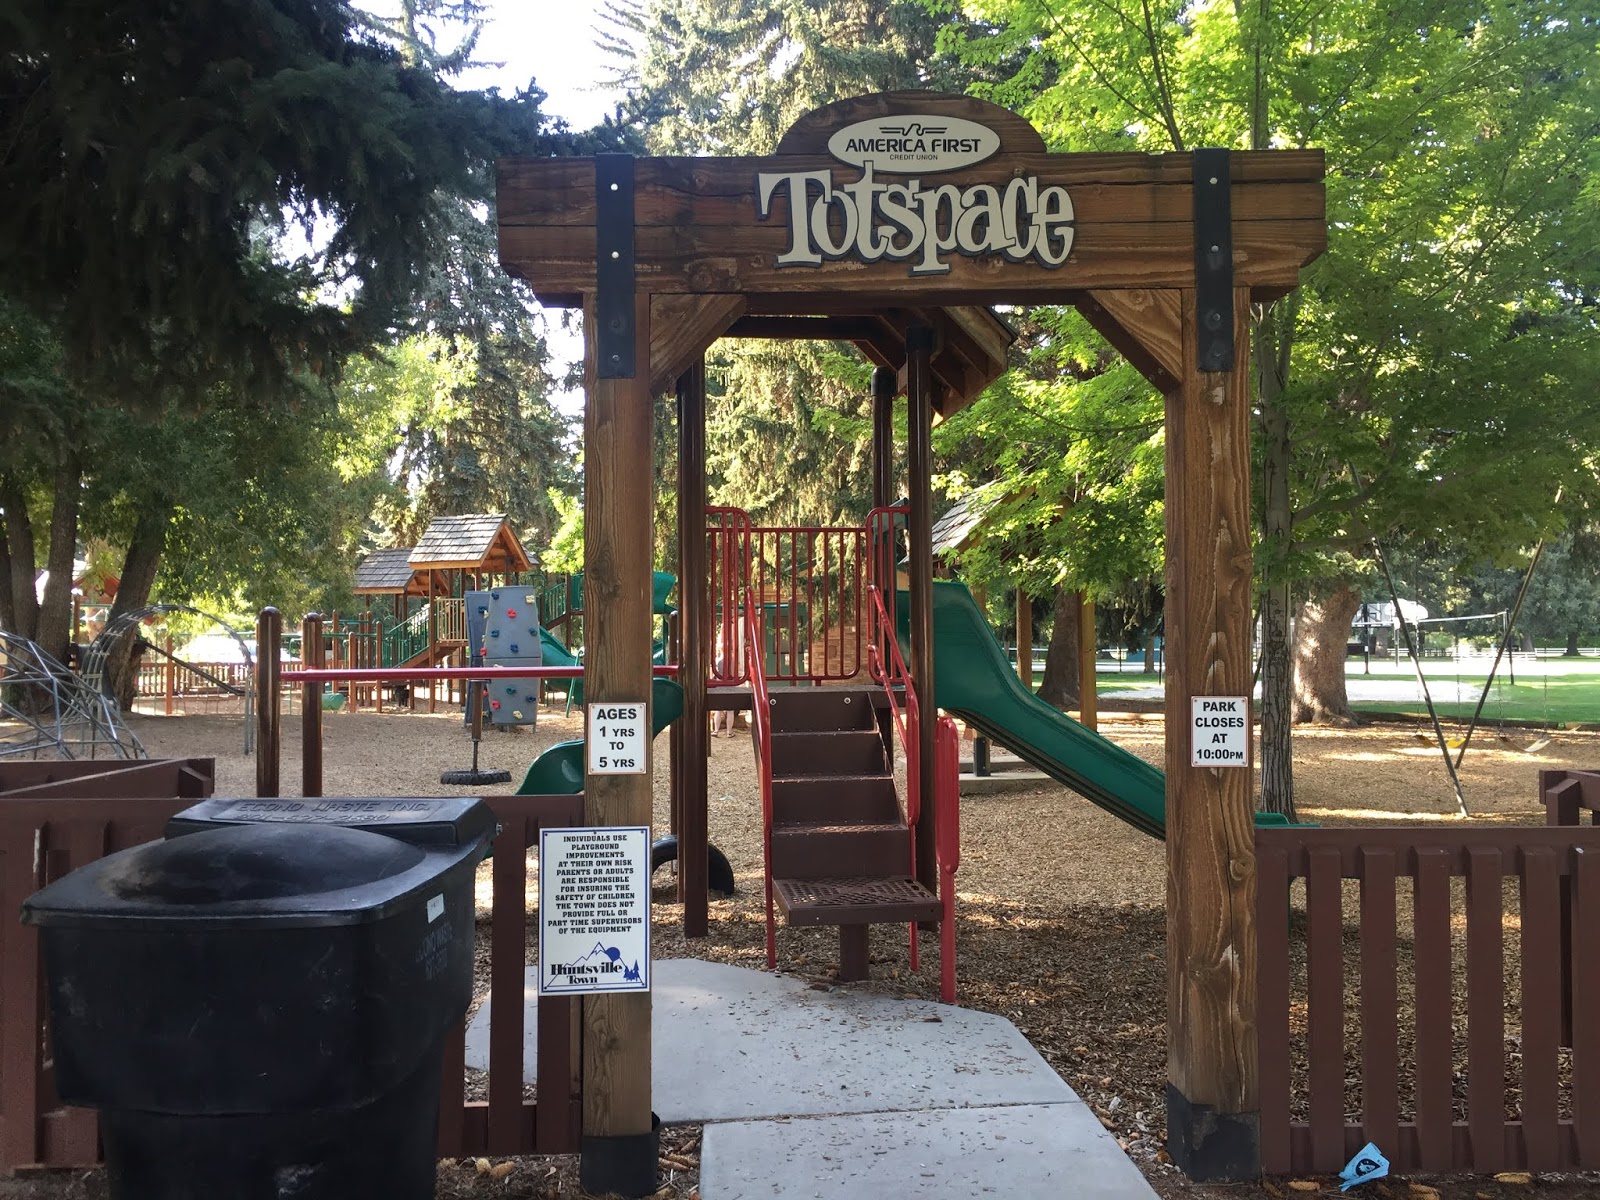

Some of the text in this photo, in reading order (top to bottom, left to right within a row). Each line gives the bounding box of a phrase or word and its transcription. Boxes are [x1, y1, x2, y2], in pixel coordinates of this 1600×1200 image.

[845, 139, 981, 152] AMERICA FIRST
[758, 160, 1075, 274] Totspace
[1203, 702, 1236, 712] PARK
[596, 708, 637, 720] AGES
[1195, 718, 1244, 728] CLOSES
[600, 726, 635, 737] 1 YRS
[1212, 734, 1228, 743] AT
[609, 742, 624, 750] TO
[1196, 749, 1243, 759] 10:00PM
[599, 757, 635, 768] 5 YRS
[236, 802, 431, 812] ECONO WASTE INC.
[566, 851, 624, 859] IMPROVEMENTS
[578, 876, 629, 884] RESPONSIBLE
[591, 917, 642, 925] SUPERVISORS
[550, 962, 622, 975] Huntsville
[567, 975, 598, 984] Town
